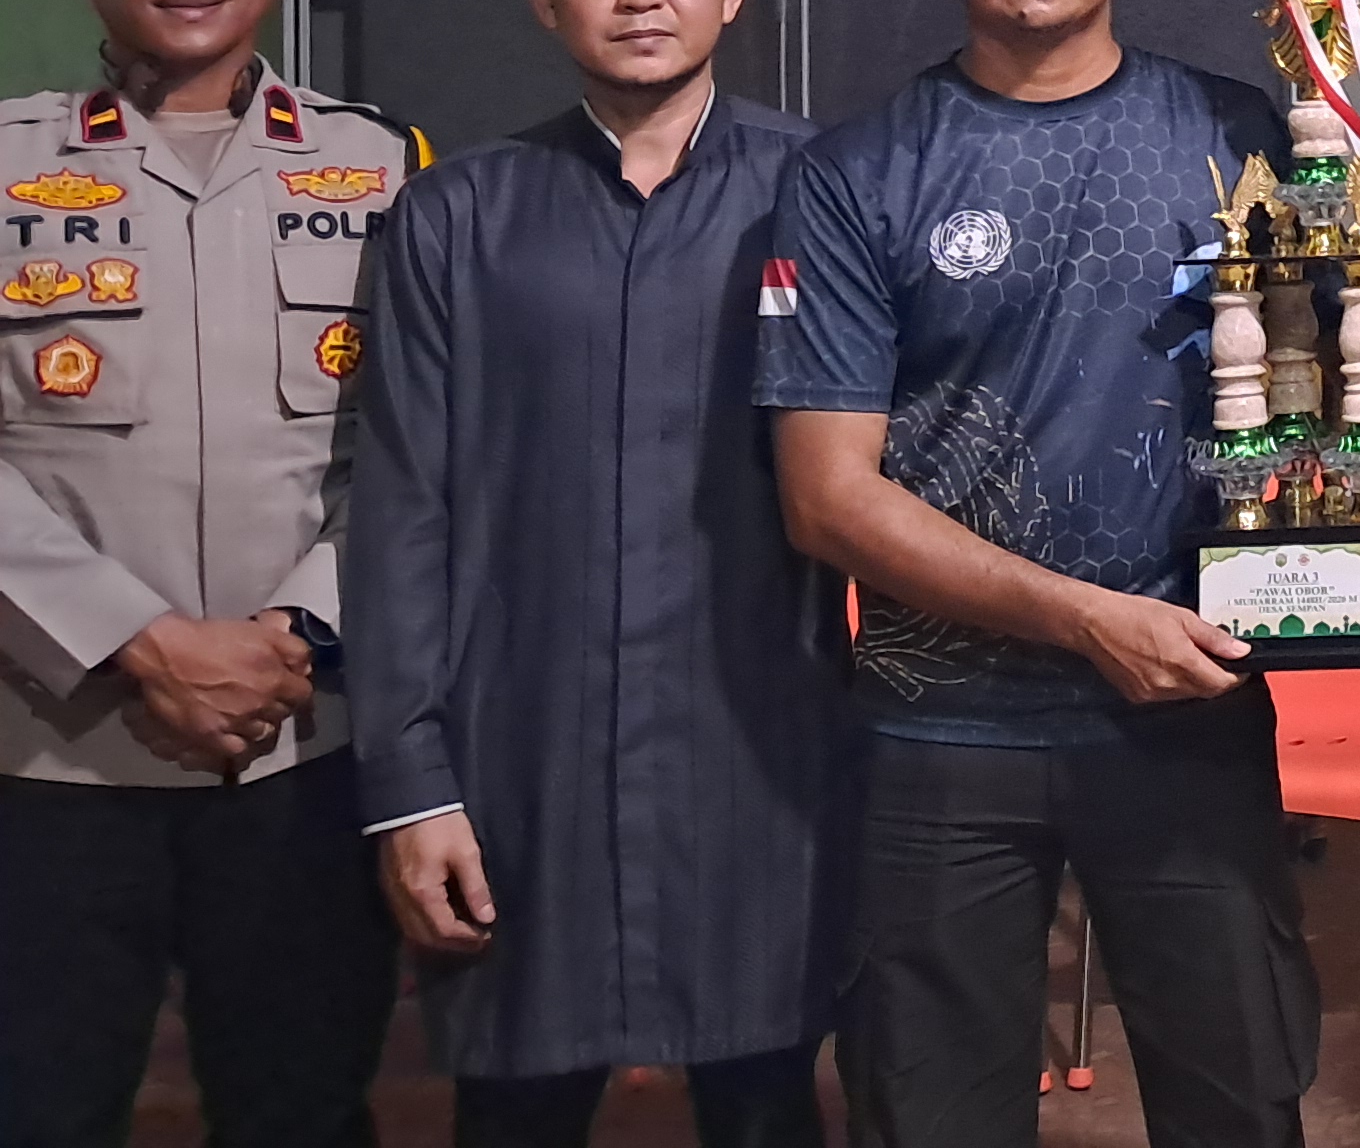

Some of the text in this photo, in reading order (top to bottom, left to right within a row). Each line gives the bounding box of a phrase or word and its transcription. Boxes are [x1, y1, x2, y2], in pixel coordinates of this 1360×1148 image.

[6, 214, 132, 247] TRI
[277, 211, 386, 241] POLR
[1267, 572, 1319, 584] JUARA 3
